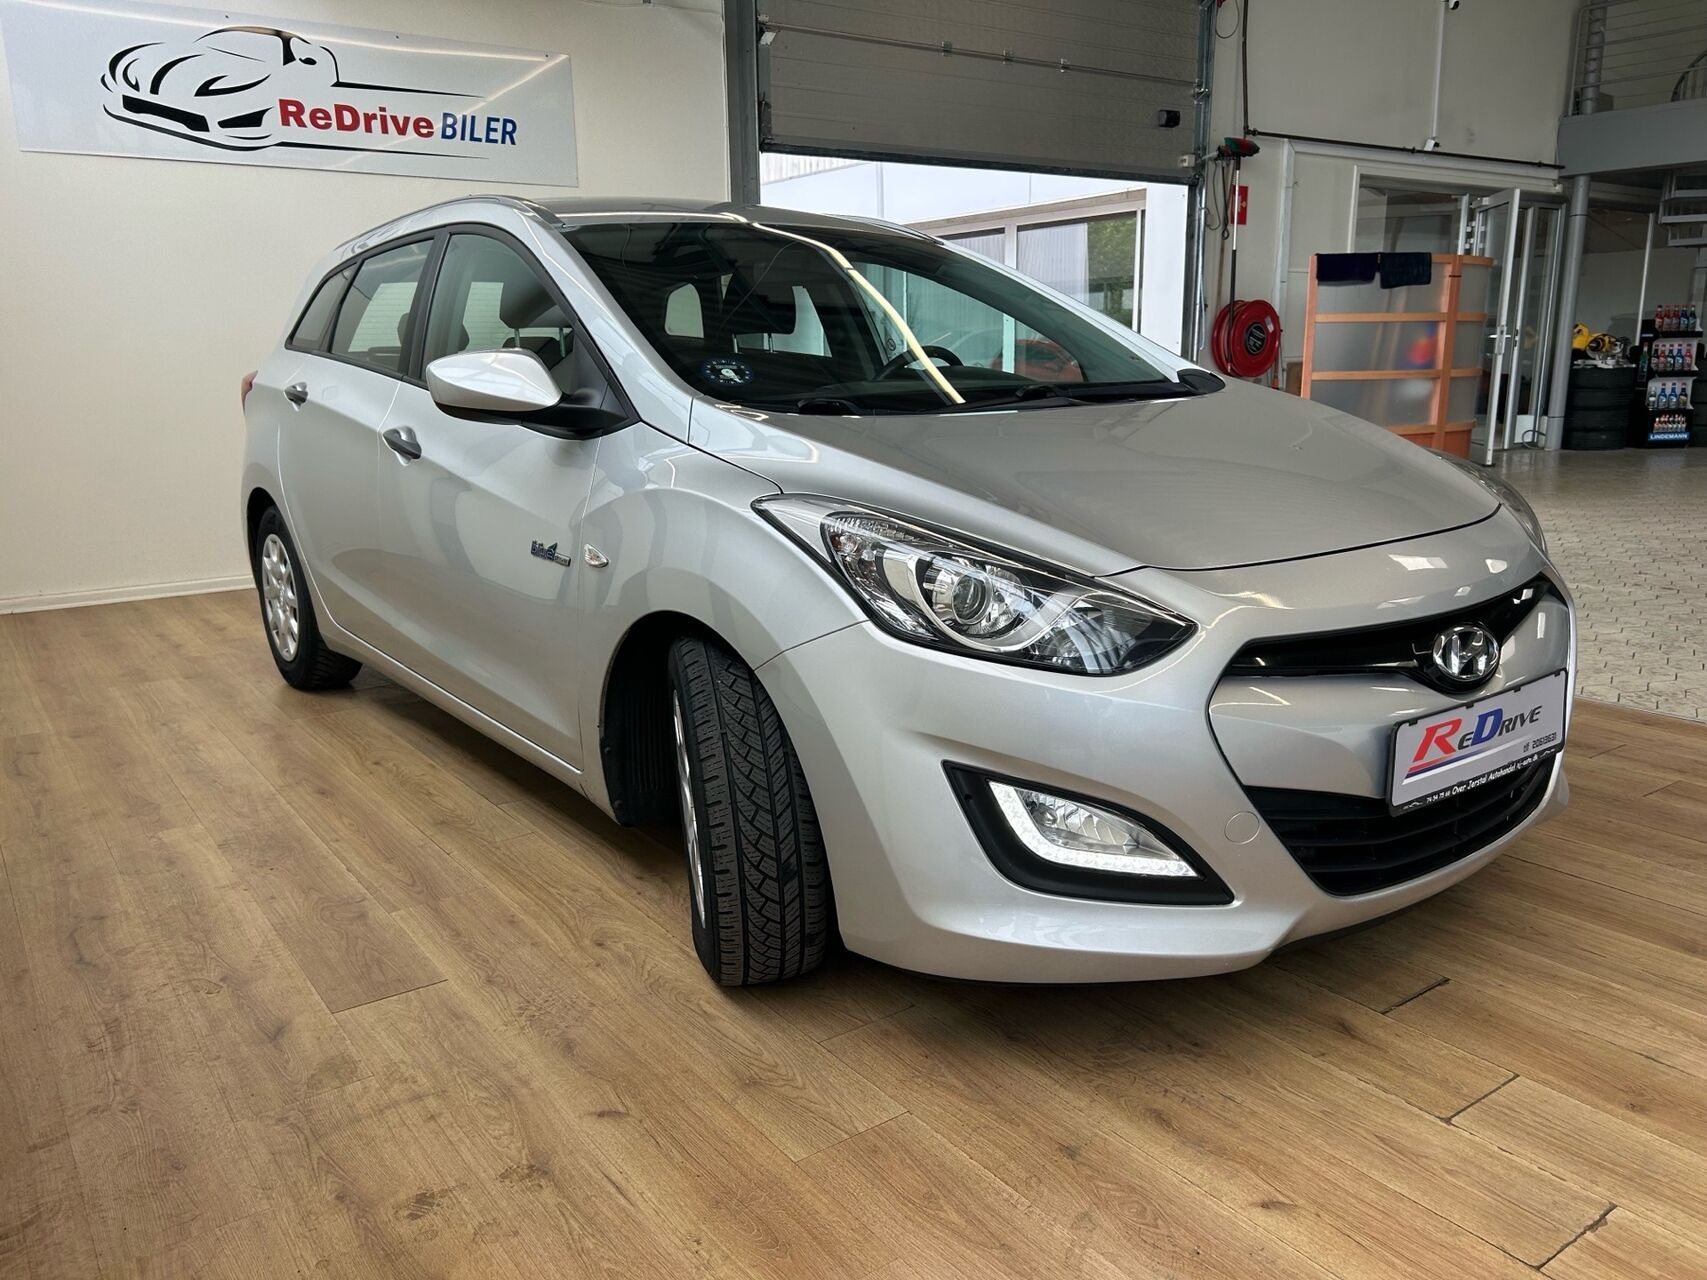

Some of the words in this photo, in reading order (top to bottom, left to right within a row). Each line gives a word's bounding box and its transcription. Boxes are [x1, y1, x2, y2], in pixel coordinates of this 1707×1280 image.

[279, 98, 435, 139] ReDrive
[441, 112, 518, 146] BILER
[1452, 785, 1467, 795] Over
[1467, 774, 1488, 790] Jerstal
